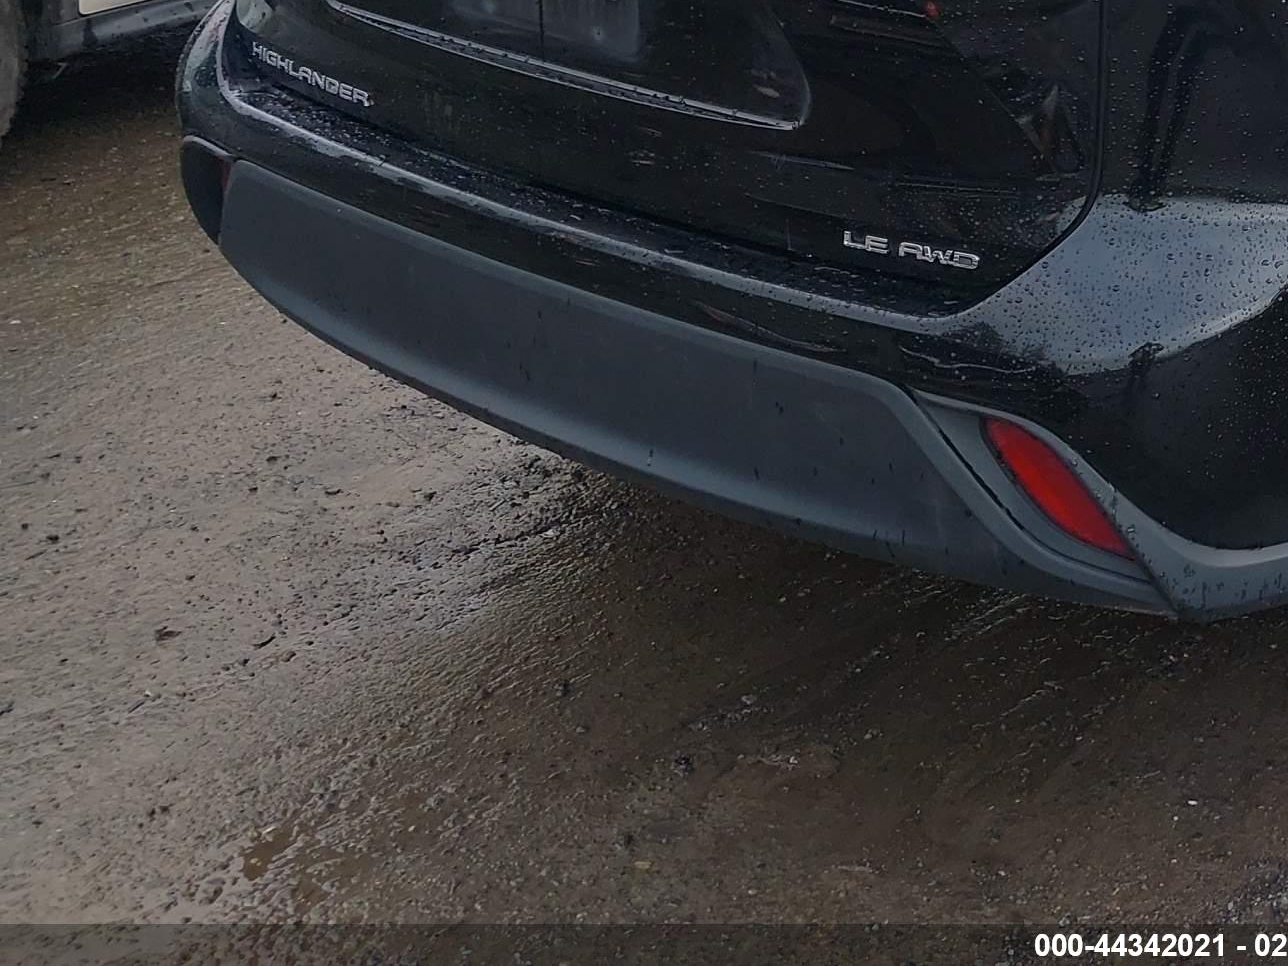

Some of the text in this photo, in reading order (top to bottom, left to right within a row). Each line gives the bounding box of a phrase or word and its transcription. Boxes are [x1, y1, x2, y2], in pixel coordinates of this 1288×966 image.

[252, 41, 370, 107] HIGHLANDER
[843, 230, 980, 270] LE AWD
